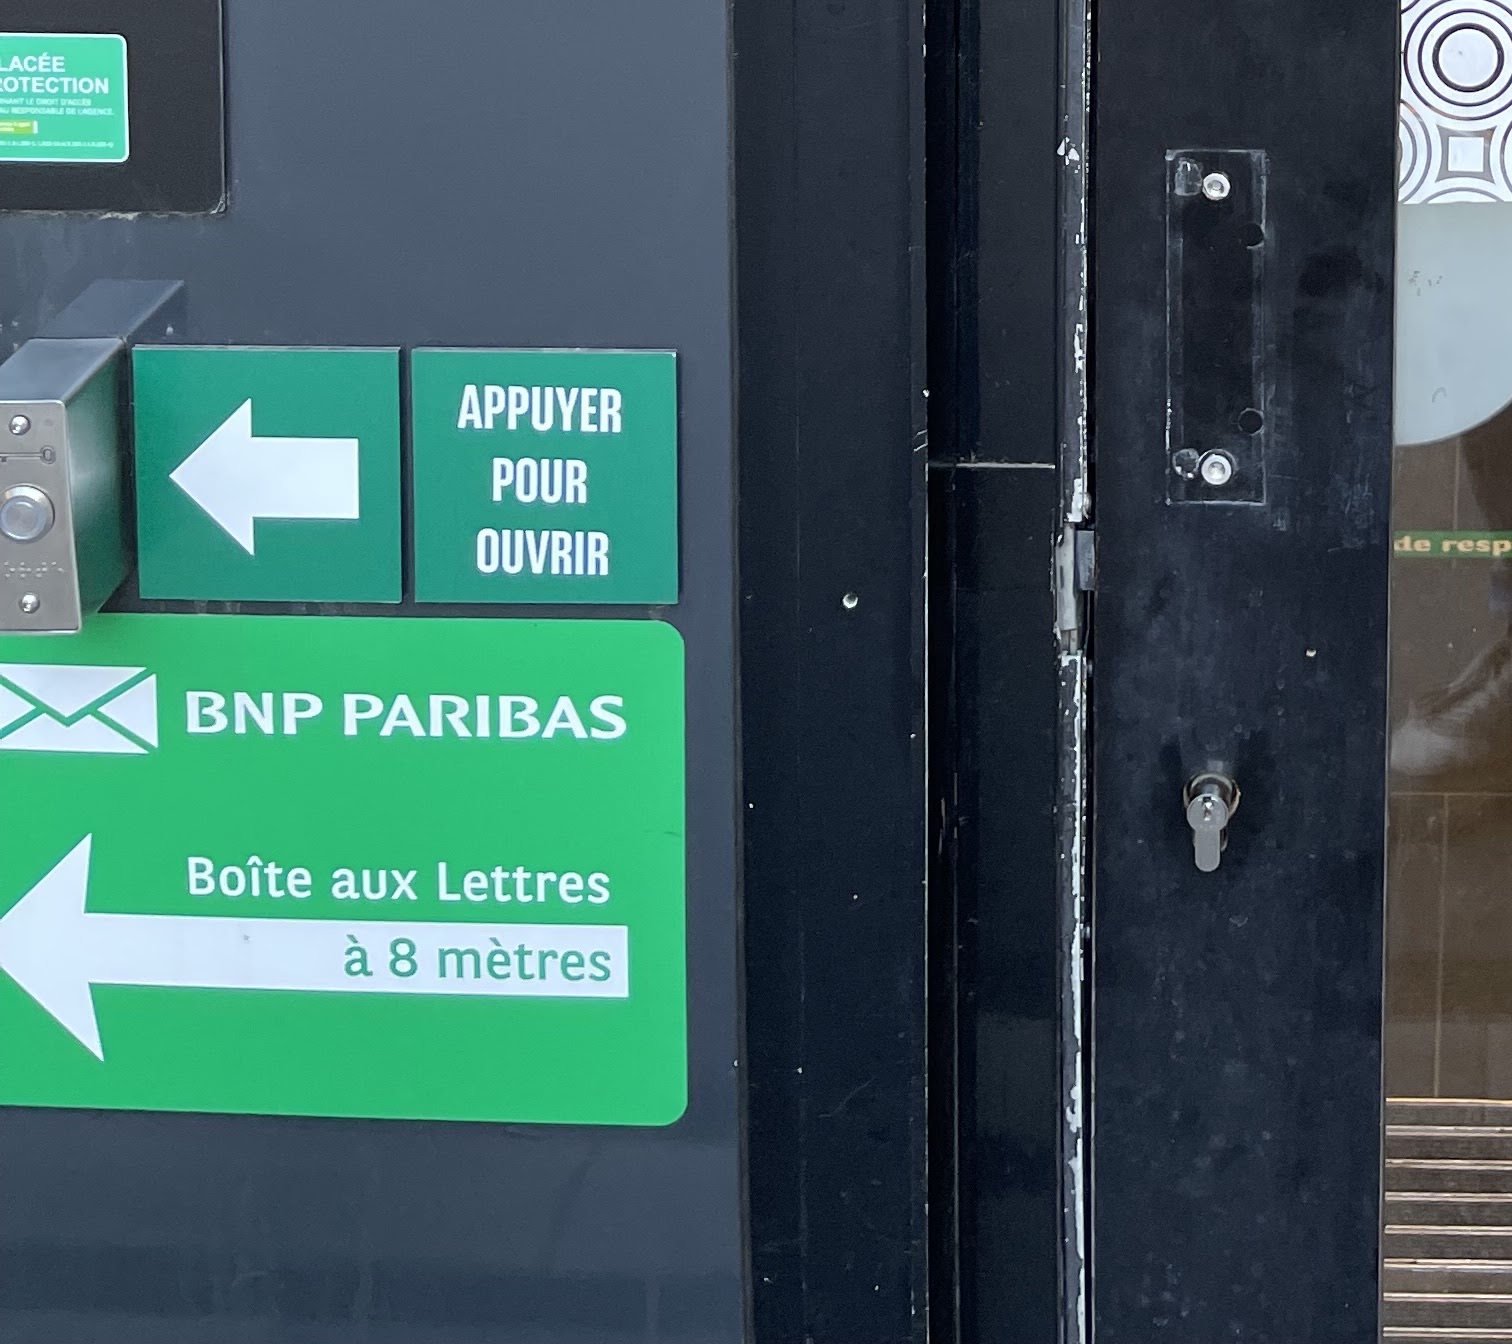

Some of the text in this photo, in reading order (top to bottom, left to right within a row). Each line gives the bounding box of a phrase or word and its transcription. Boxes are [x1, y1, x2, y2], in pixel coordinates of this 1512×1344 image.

[457, 384, 622, 434] APPUYER
[492, 457, 587, 506] POUR
[475, 527, 610, 578] OUVRIR
[1394, 534, 1431, 553] de
[185, 690, 628, 742] BNP PARIBAS
[186, 855, 611, 906] Boîte aux Lettres
[343, 933, 611, 982] à 8 mètres
